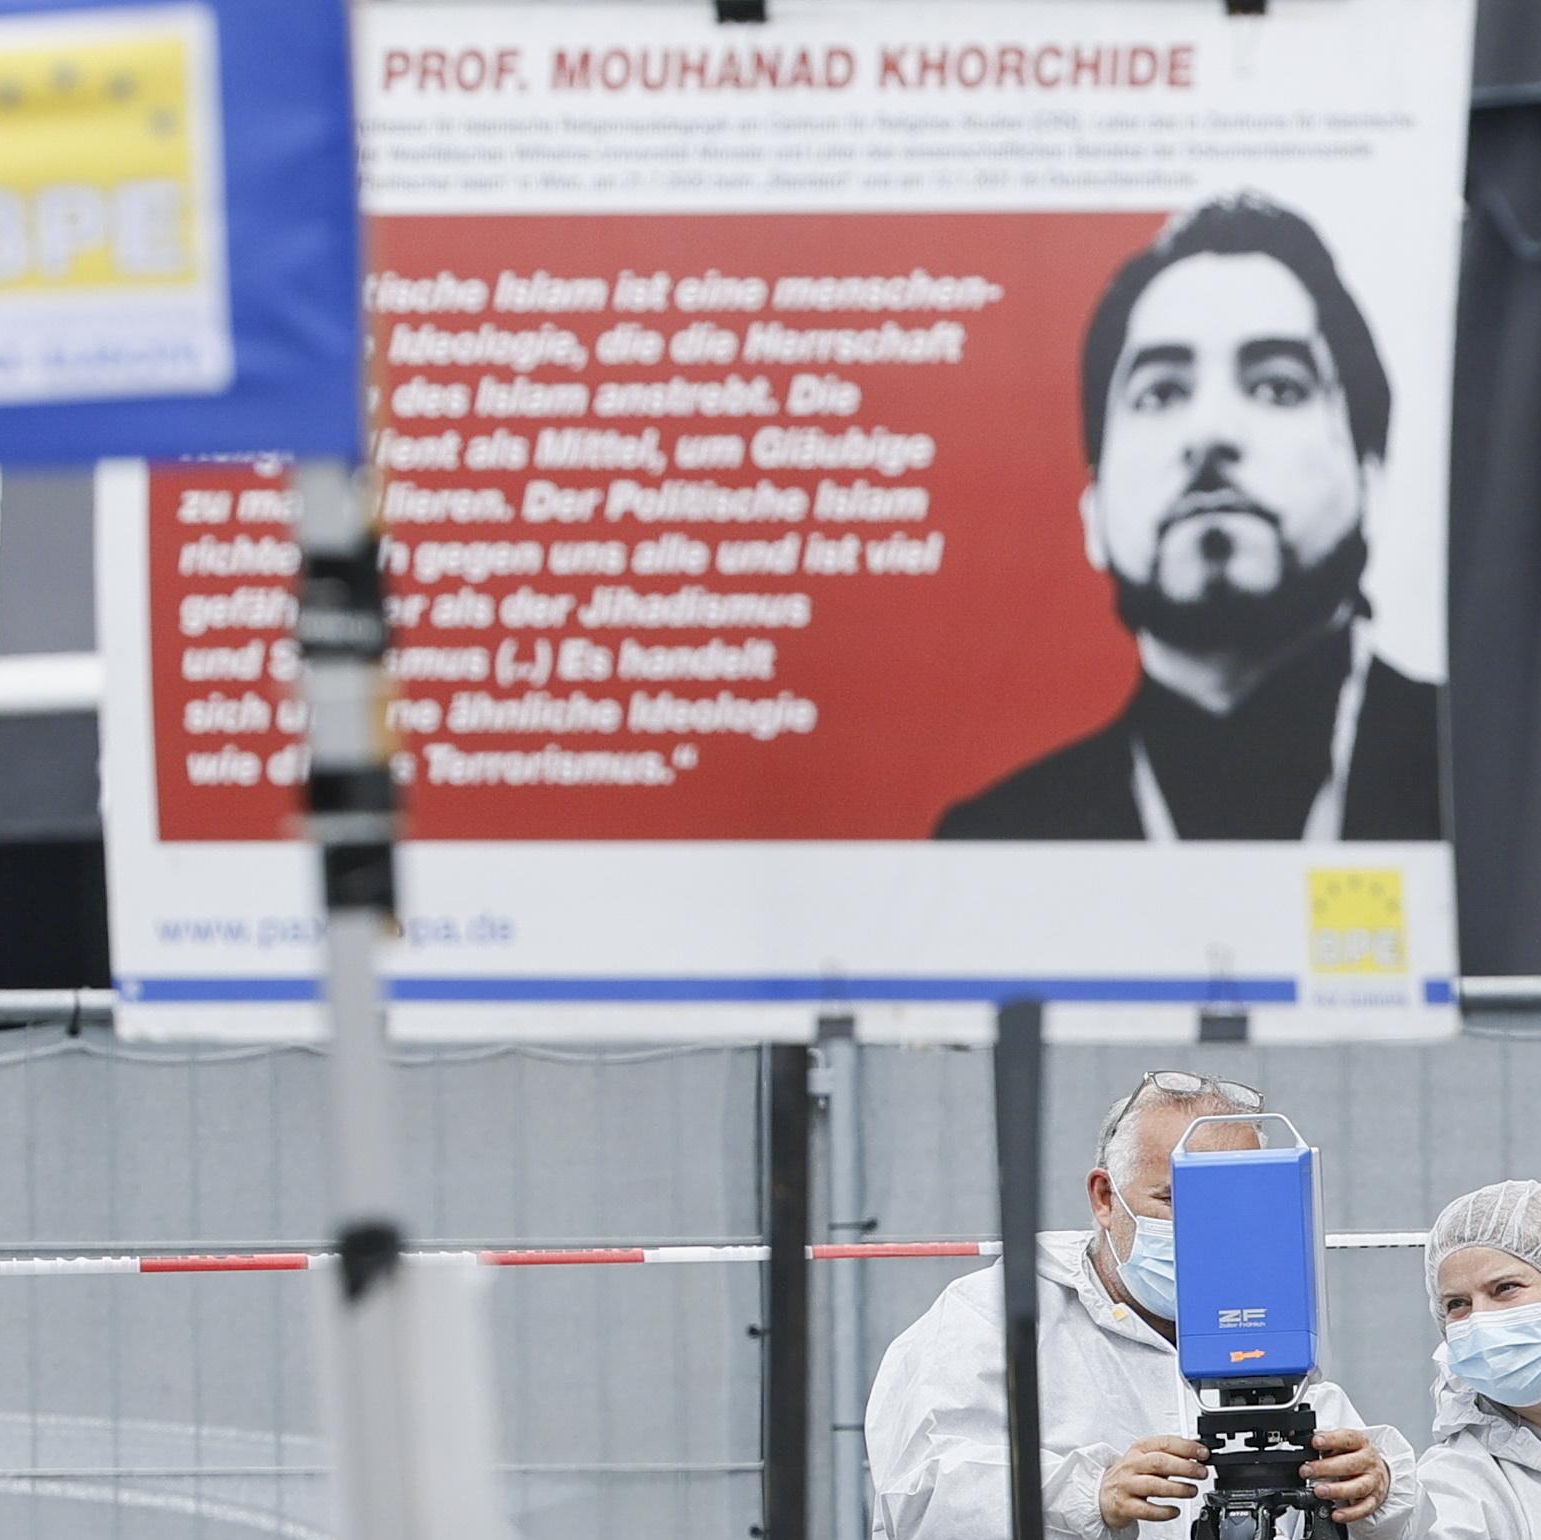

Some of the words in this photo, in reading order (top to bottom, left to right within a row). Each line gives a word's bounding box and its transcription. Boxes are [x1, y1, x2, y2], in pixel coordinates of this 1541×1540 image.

[384, 50, 526, 91] PROF.
[554, 49, 854, 91] MOUHANAD
[880, 46, 1193, 89] KHORCHIDE
[494, 270, 609, 313] Islam
[612, 270, 672, 312] ist
[674, 269, 768, 312] eine
[772, 268, 1003, 311] menschen-
[388, 323, 588, 372] Ideologie,
[596, 323, 665, 364] die
[669, 322, 738, 364] die
[743, 321, 966, 363] Herrschaft
[392, 376, 469, 418] des
[475, 376, 589, 417] Islam
[594, 375, 778, 416] anstrebt.
[787, 374, 861, 415] Die
[465, 429, 528, 469] als
[534, 428, 666, 474] Mittel,
[675, 435, 744, 468] um
[751, 426, 934, 476] Gläubige
[178, 491, 232, 523] zu
[522, 481, 601, 522] Der
[605, 480, 808, 521] Politische
[814, 480, 928, 521] Islam
[414, 542, 543, 582] gegen
[548, 541, 626, 574] uns
[632, 534, 709, 574] alle
[716, 533, 800, 574] und
[804, 533, 860, 573] ist
[866, 532, 943, 574] viel
[431, 588, 494, 627] als
[500, 588, 573, 627] der
[578, 587, 810, 627] Jihadismus
[183, 634, 264, 680] und
[558, 639, 611, 680] Es
[618, 640, 774, 680] handelt
[185, 693, 270, 732] sich
[448, 693, 621, 732] ähnliche
[629, 693, 816, 739] Ideologie
[187, 746, 260, 784] wie
[1218, 1308, 1268, 1321] ZF
